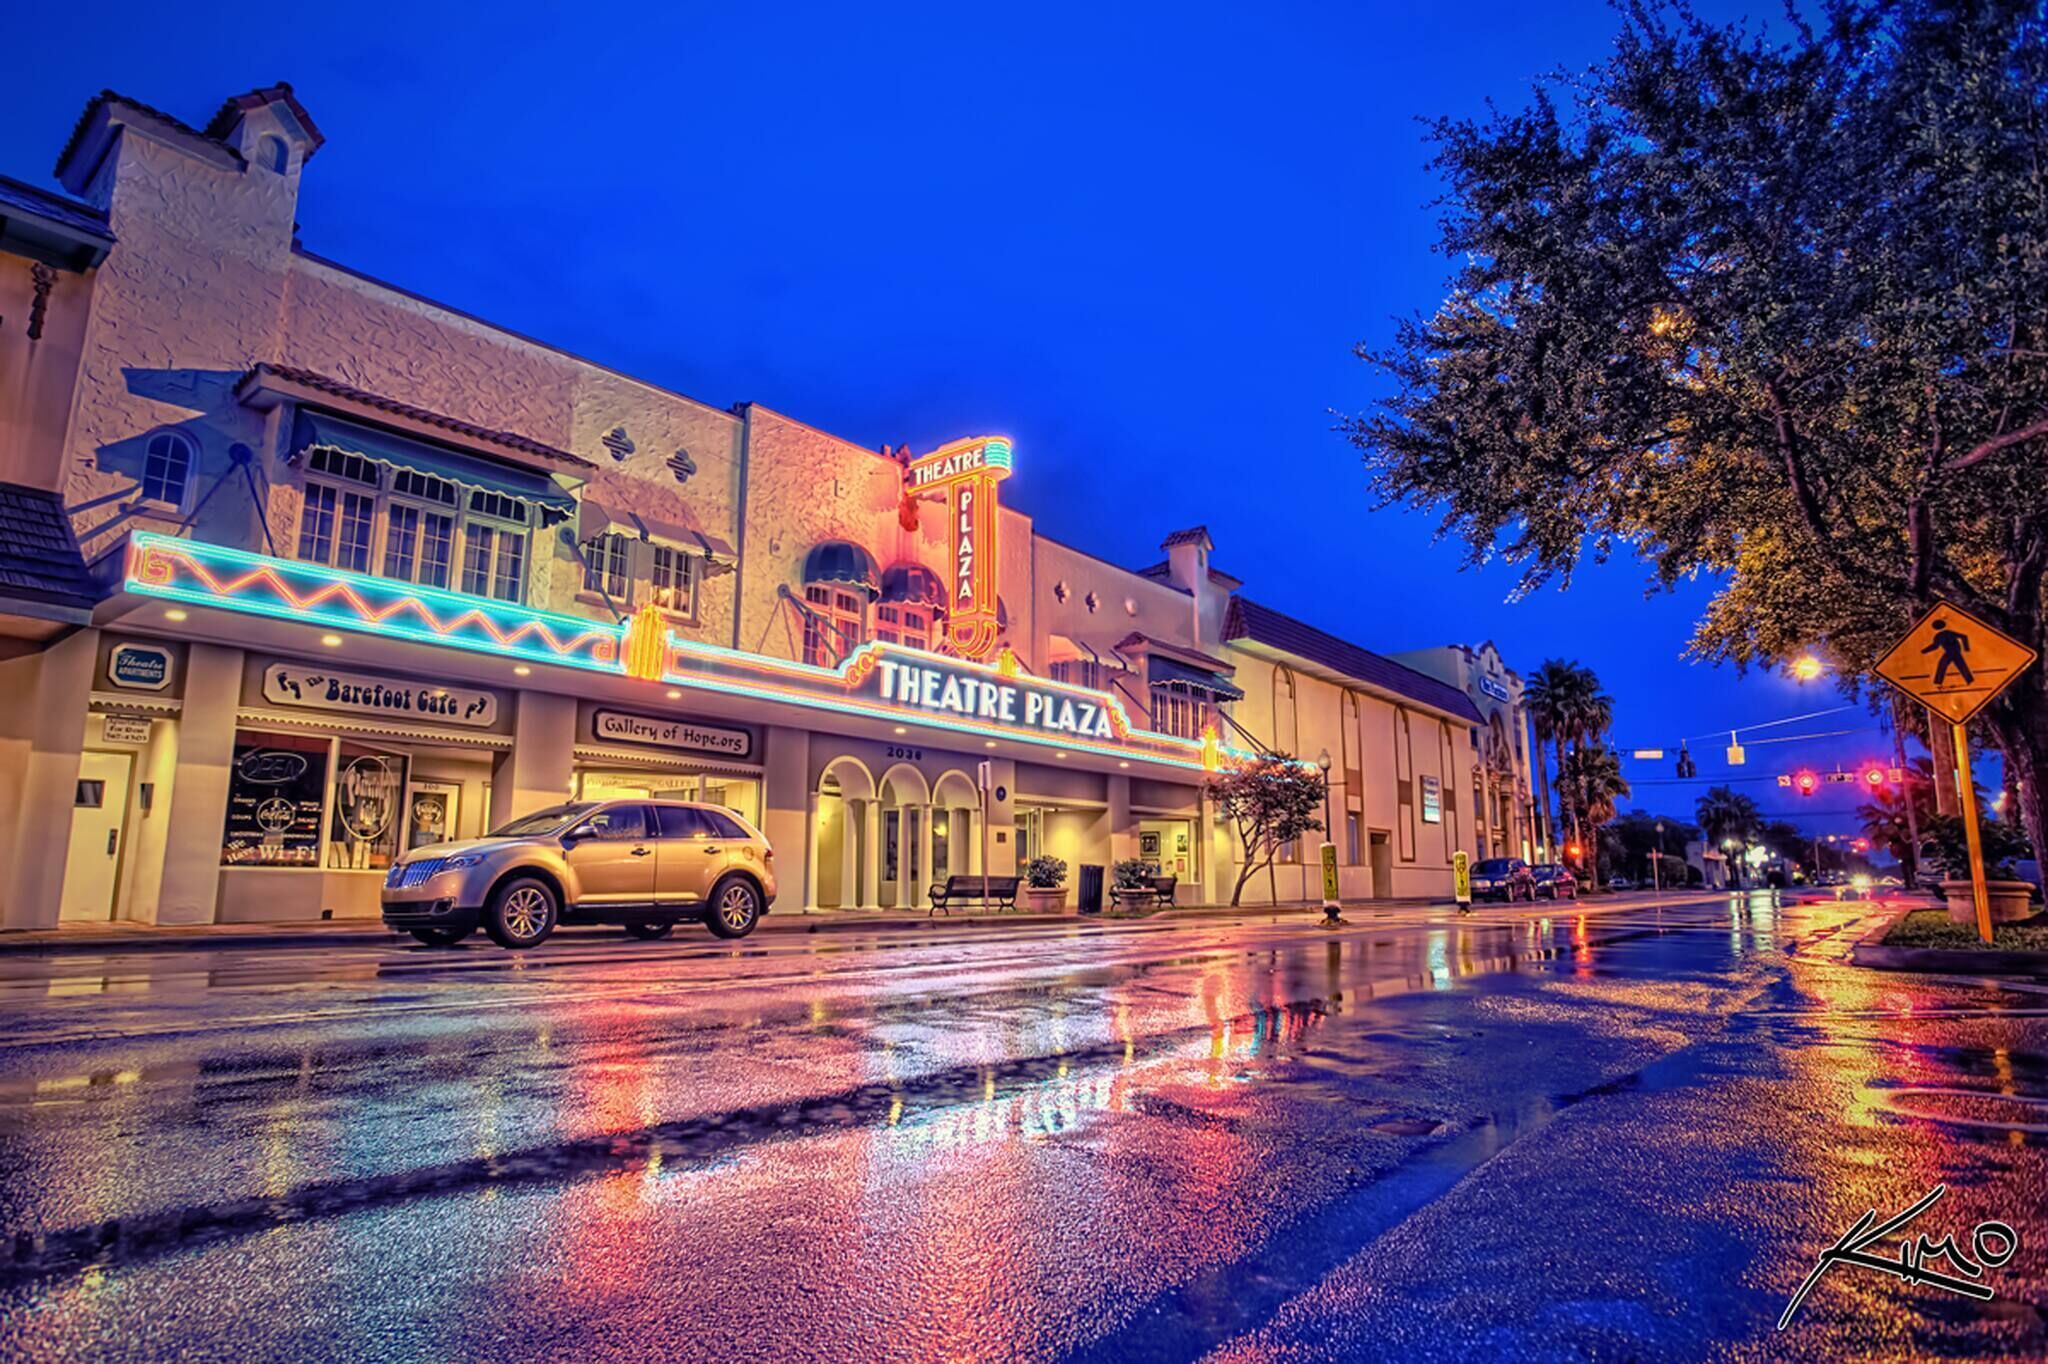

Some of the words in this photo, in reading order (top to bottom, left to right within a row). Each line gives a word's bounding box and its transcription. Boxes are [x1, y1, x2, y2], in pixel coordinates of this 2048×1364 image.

[914, 452, 983, 486] THEATRE
[959, 491, 973, 599] PLAZA
[325, 678, 412, 711] Barefoot
[416, 689, 458, 716] Cafe
[878, 659, 1017, 722] THEATRE
[1024, 691, 1114, 739] PLAZA
[605, 717, 658, 741] Gallery
[663, 725, 679, 739] of
[683, 728, 742, 751] Hope.org
[257, 844, 316, 861] Wi-Fi
